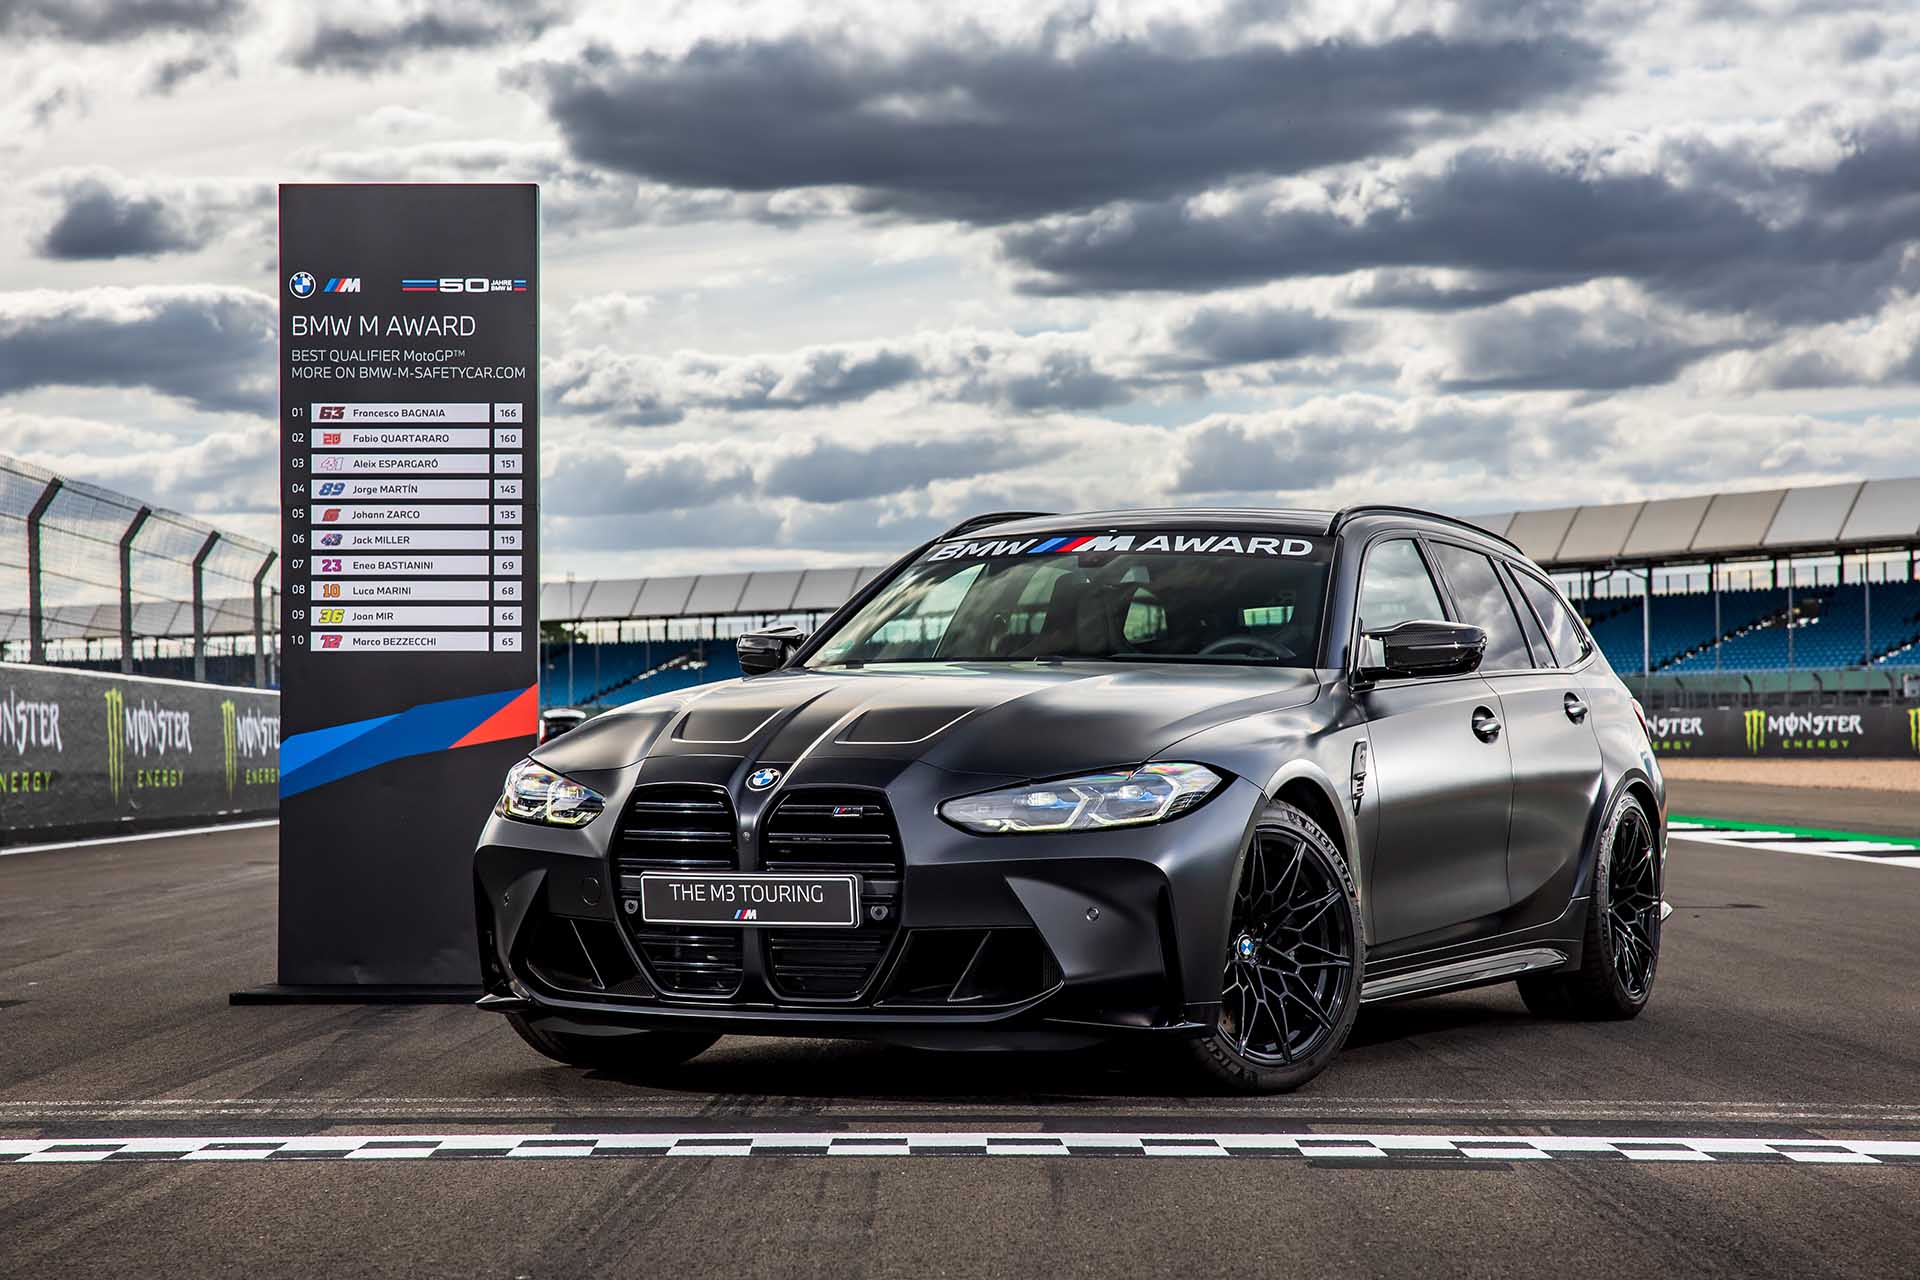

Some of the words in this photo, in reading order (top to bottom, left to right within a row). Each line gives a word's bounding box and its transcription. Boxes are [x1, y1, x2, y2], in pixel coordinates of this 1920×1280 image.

[440, 278, 490, 293] 50
[292, 316, 351, 336] BMW
[360, 316, 378, 336] M
[386, 316, 476, 336] AWARD
[291, 350, 325, 362] BEST
[330, 350, 400, 362] QUALIFIER
[291, 367, 331, 379] MORE
[336, 367, 355, 379] ON
[360, 367, 526, 379] BMW-M-SAFETYCAR.COM
[292, 408, 303, 417] 01
[319, 406, 346, 419] 63
[353, 409, 399, 417] Francesco
[402, 409, 445, 417] BAGNAIA
[292, 433, 304, 442] 02
[353, 435, 378, 443] Fabio
[381, 435, 449, 443] QUARTARARO
[292, 459, 304, 467] 03
[353, 460, 376, 468] Aleix
[379, 460, 438, 468] ESPARGARÓ
[501, 460, 515, 468] 151
[292, 484, 304, 493] 04
[319, 483, 346, 496] 89
[353, 486, 377, 495] Jorge
[380, 485, 417, 493] MARTÍN
[292, 509, 304, 518] 05
[352, 511, 384, 519] Johann
[387, 511, 420, 519] ZARCO
[501, 511, 515, 519] 135
[292, 534, 304, 543] 06
[353, 536, 372, 545] Jack
[927, 538, 1038, 562] BMW
[1138, 536, 1313, 556] AWARD
[292, 560, 303, 569] 07
[322, 559, 342, 572] 23
[292, 585, 305, 594] 08
[323, 584, 340, 597] 10
[353, 587, 374, 595] Luca
[377, 587, 410, 595] MARINI
[502, 587, 513, 595] 68
[292, 611, 304, 619] 09
[319, 609, 345, 623] 36
[352, 613, 373, 621] Joan
[291, 636, 303, 645] 10
[353, 638, 380, 646] Marco
[383, 638, 436, 646] BEZZECCHI
[502, 638, 513, 646] 65
[0, 688, 63, 755] NSTER
[1782, 739, 1849, 749] ENERGY
[136, 769, 183, 788] ENERGY
[245, 768, 280, 785] ENERG
[1304, 821, 1354, 893] MICHELIN
[669, 884, 705, 901] THE
[710, 885, 735, 901] M3
[738, 885, 823, 902] TOURING
